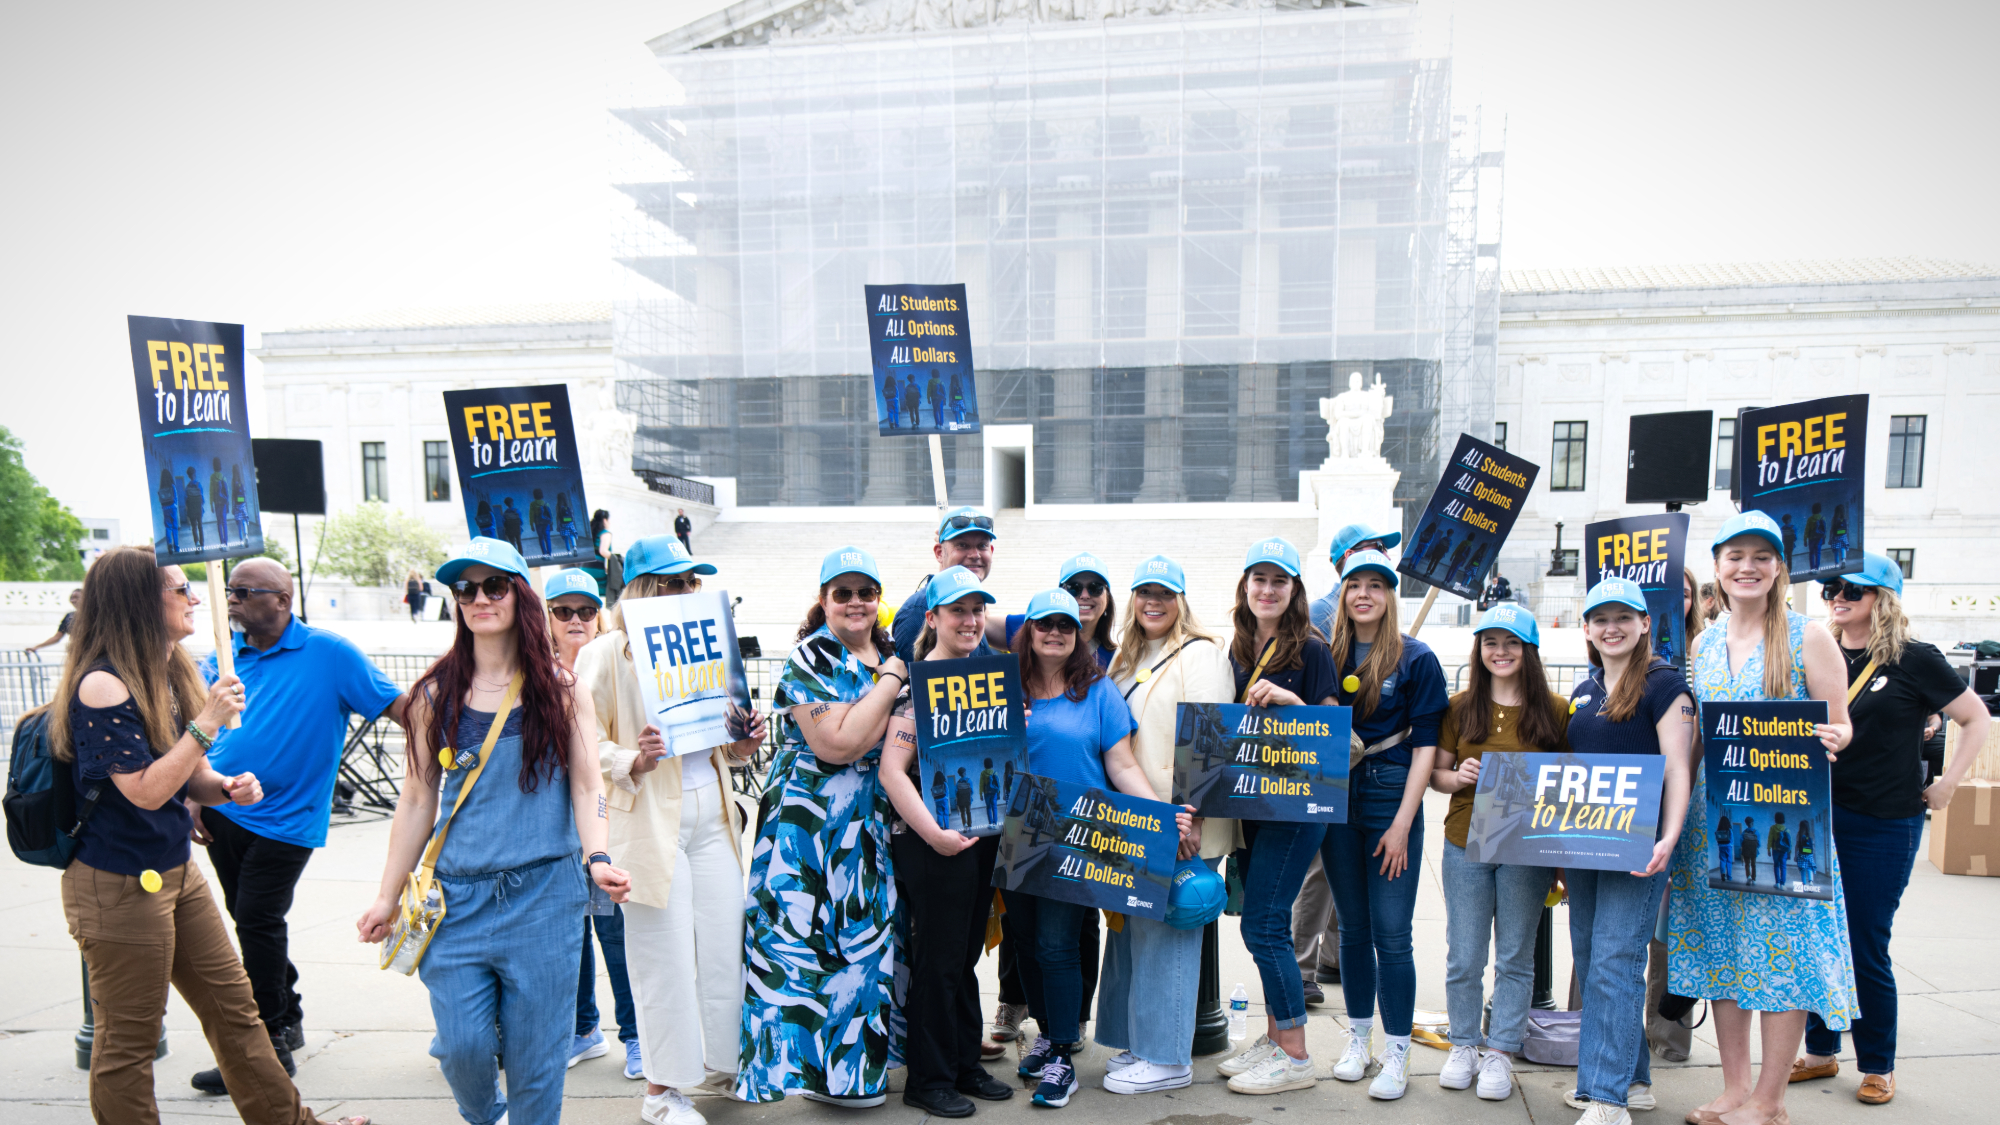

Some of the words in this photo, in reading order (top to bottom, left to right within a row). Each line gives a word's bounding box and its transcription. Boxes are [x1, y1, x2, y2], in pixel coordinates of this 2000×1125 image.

[878, 294, 898, 312] ALL
[900, 295, 960, 311] Students.
[885, 318, 906, 337] ALL
[908, 320, 958, 338] Options.
[147, 340, 229, 390] FREE
[890, 346, 911, 364] ALL
[912, 347, 958, 363] Dollars.
[154, 380, 176, 424] to
[182, 379, 231, 426] Learn
[463, 402, 556, 442] FREE
[1758, 412, 1847, 462] FREE
[470, 435, 492, 468] to
[499, 432, 558, 467] Learn
[1462, 448, 1483, 468] ALL
[1480, 456, 1527, 490] Students.
[1758, 454, 1779, 486] to
[1784, 448, 1846, 484] Learn
[1454, 472, 1476, 493] ALL
[1473, 482, 1513, 511] Options.
[1443, 498, 1465, 518] ALL
[1462, 506, 1498, 534] Dollars.
[840, 552, 862, 562] FREE
[1598, 528, 1670, 568] FREE
[1148, 561, 1168, 570] FREE
[1602, 583, 1624, 594] FREE
[1495, 608, 1518, 618] FREE
[644, 618, 722, 670] FREE
[654, 662, 673, 702] to
[676, 657, 728, 699] Learn
[928, 672, 1008, 714] FREE
[810, 703, 830, 719] FREE
[931, 706, 950, 738] to
[956, 702, 1008, 737] Learn
[1237, 714, 1260, 734] ALL
[1263, 718, 1332, 736] Students.
[1682, 706, 1694, 716] FRE
[1716, 713, 1740, 736] ALL
[1742, 716, 1814, 736] Students
[896, 730, 916, 744] FREE
[456, 750, 472, 764] FREE
[1236, 742, 1258, 762] ALL
[1262, 746, 1320, 766] Options.
[1723, 744, 1746, 767] ALL
[1750, 748, 1812, 771] Options.
[1234, 774, 1256, 794] ALL
[1260, 777, 1314, 796] Dollars.
[1534, 764, 1642, 806] FREE
[1727, 779, 1750, 802] ALL
[1754, 783, 1810, 805] Dollars.
[598, 794, 606, 819] FREE
[1070, 796, 1094, 818] ALL
[1096, 802, 1162, 832] Students.
[1531, 796, 1556, 829] to
[1559, 794, 1636, 834] Learn
[1064, 824, 1088, 846] ALL
[1090, 830, 1146, 858] Options.
[1058, 854, 1082, 878] ALL
[1084, 862, 1135, 889] Dollars.
[1176, 872, 1196, 886] FREE
